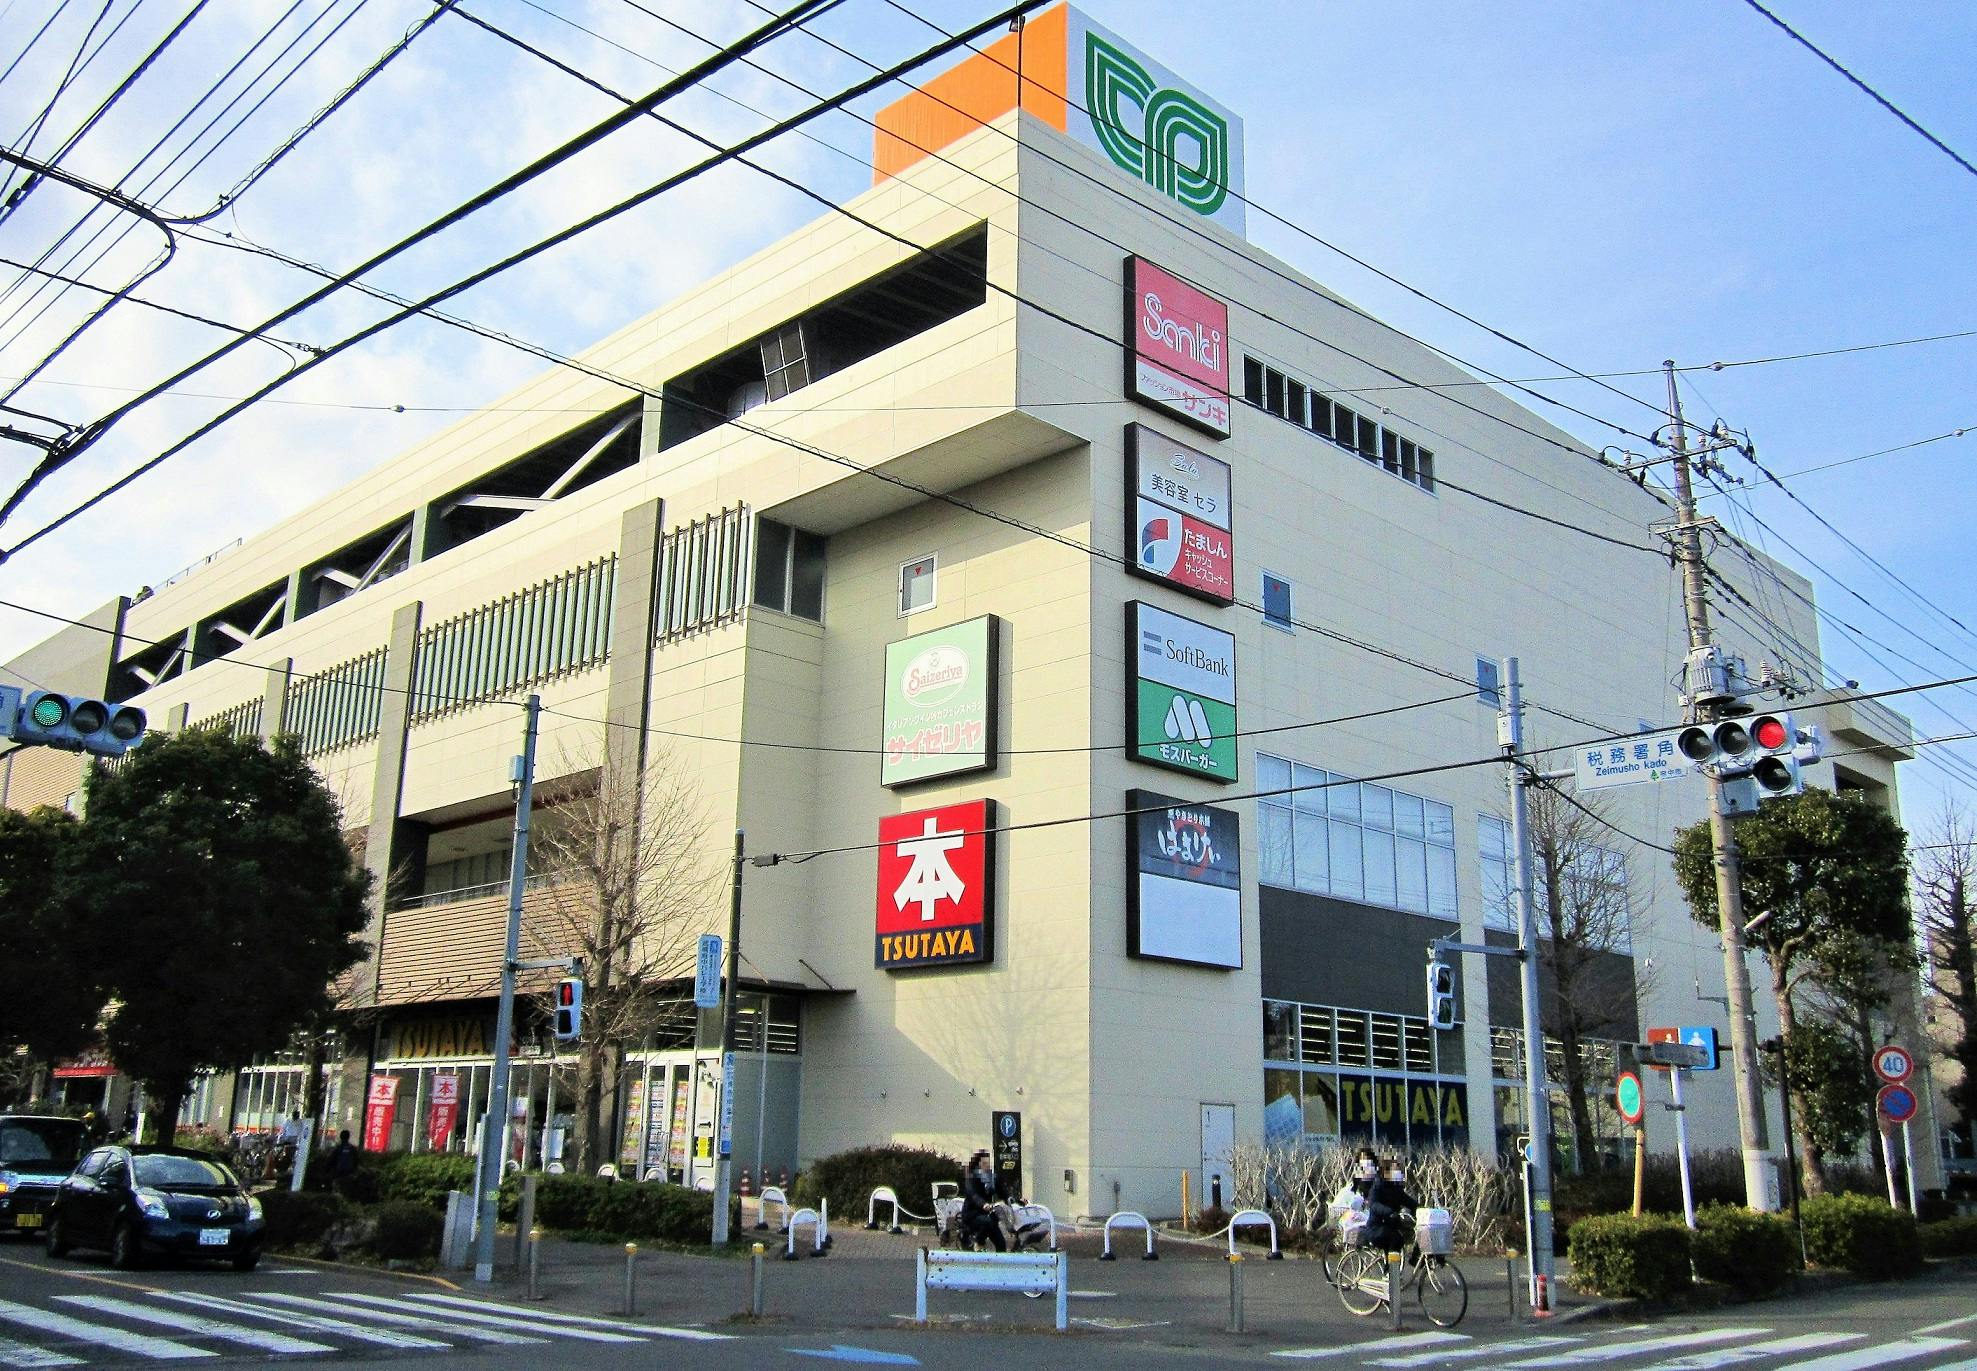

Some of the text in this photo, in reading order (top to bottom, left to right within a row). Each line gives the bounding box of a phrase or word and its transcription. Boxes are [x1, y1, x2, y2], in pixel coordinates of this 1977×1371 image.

[1143, 292, 1221, 372] Sanki
[1182, 389, 1227, 426] サンキ
[1151, 473, 1217, 513] 美容室 セラ
[1184, 529, 1228, 559] たましん
[1184, 548, 1212, 569] キャッシュ
[1184, 561, 1229, 586] サービスコーナー
[1166, 639, 1229, 677] SoftBank
[907, 664, 963, 696] Saizeriya
[886, 719, 983, 766] サイゼリヤ
[1159, 743, 1218, 770] モスバーガー
[1586, 740, 1674, 768] 税務署角
[1595, 758, 1667, 777] Zeimusho kado
[893, 817, 966, 922] 本
[881, 929, 975, 961] TSUTAYA
[1883, 1055, 1904, 1073] 40
[376, 1083, 391, 1096] 本
[439, 1081, 453, 1096] 本
[1340, 1081, 1464, 1127] TSUTAYA
[1004, 1118, 1013, 1135] P
